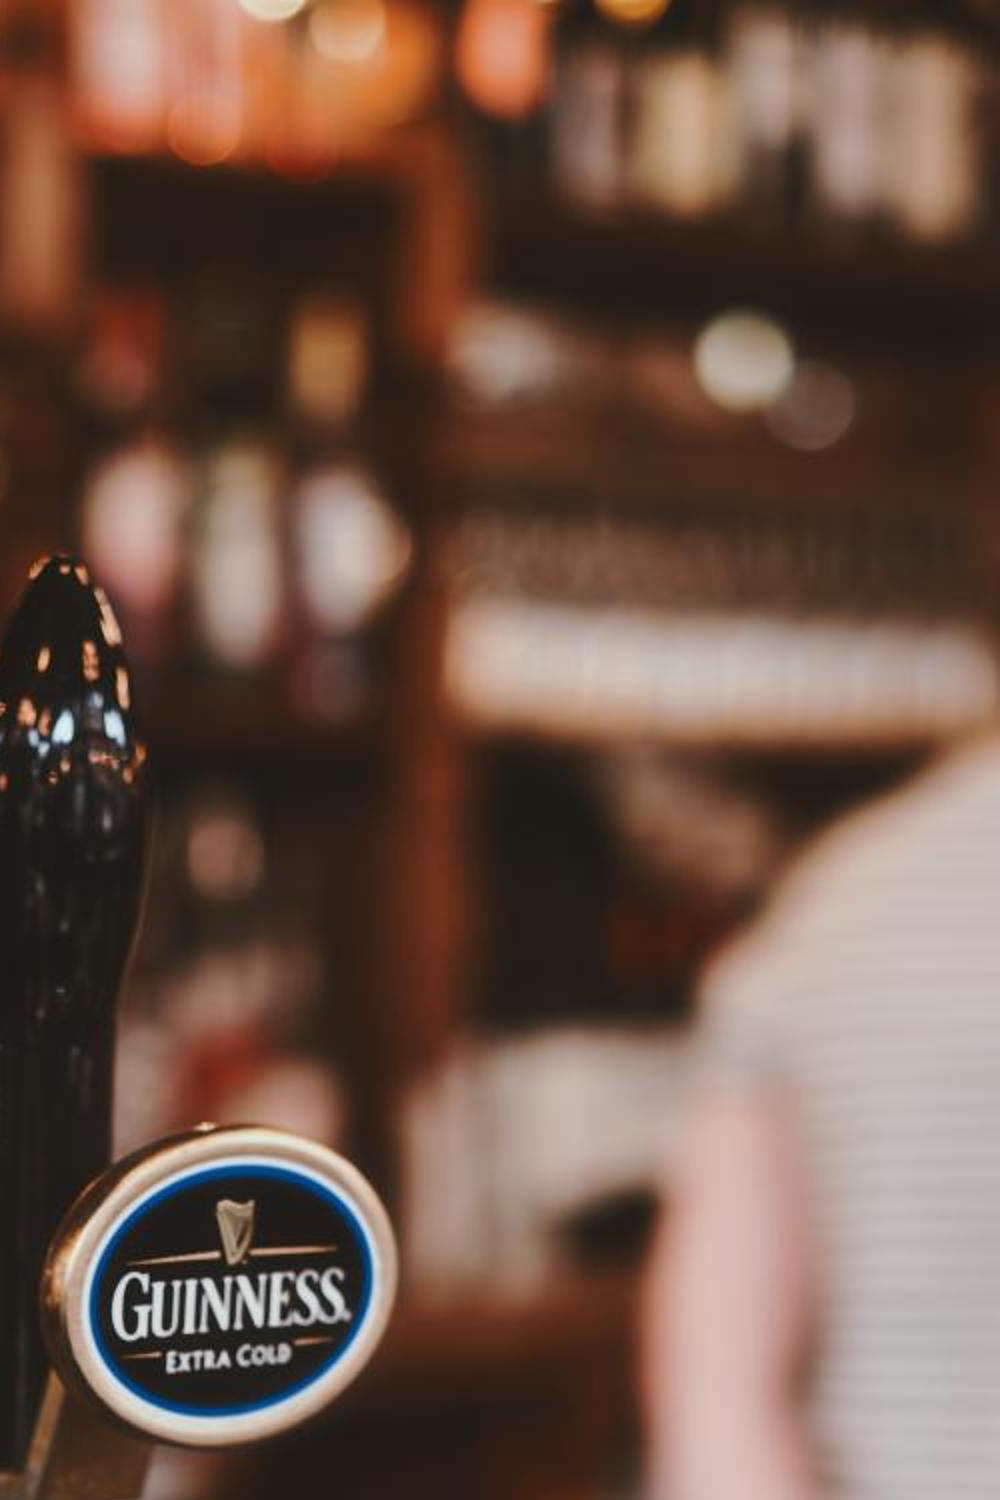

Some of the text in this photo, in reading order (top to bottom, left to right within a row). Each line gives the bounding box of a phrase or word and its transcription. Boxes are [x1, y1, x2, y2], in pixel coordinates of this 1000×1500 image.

[111, 1267, 346, 1341] GUINNESS
[165, 1342, 293, 1375] EXTRA COLD
